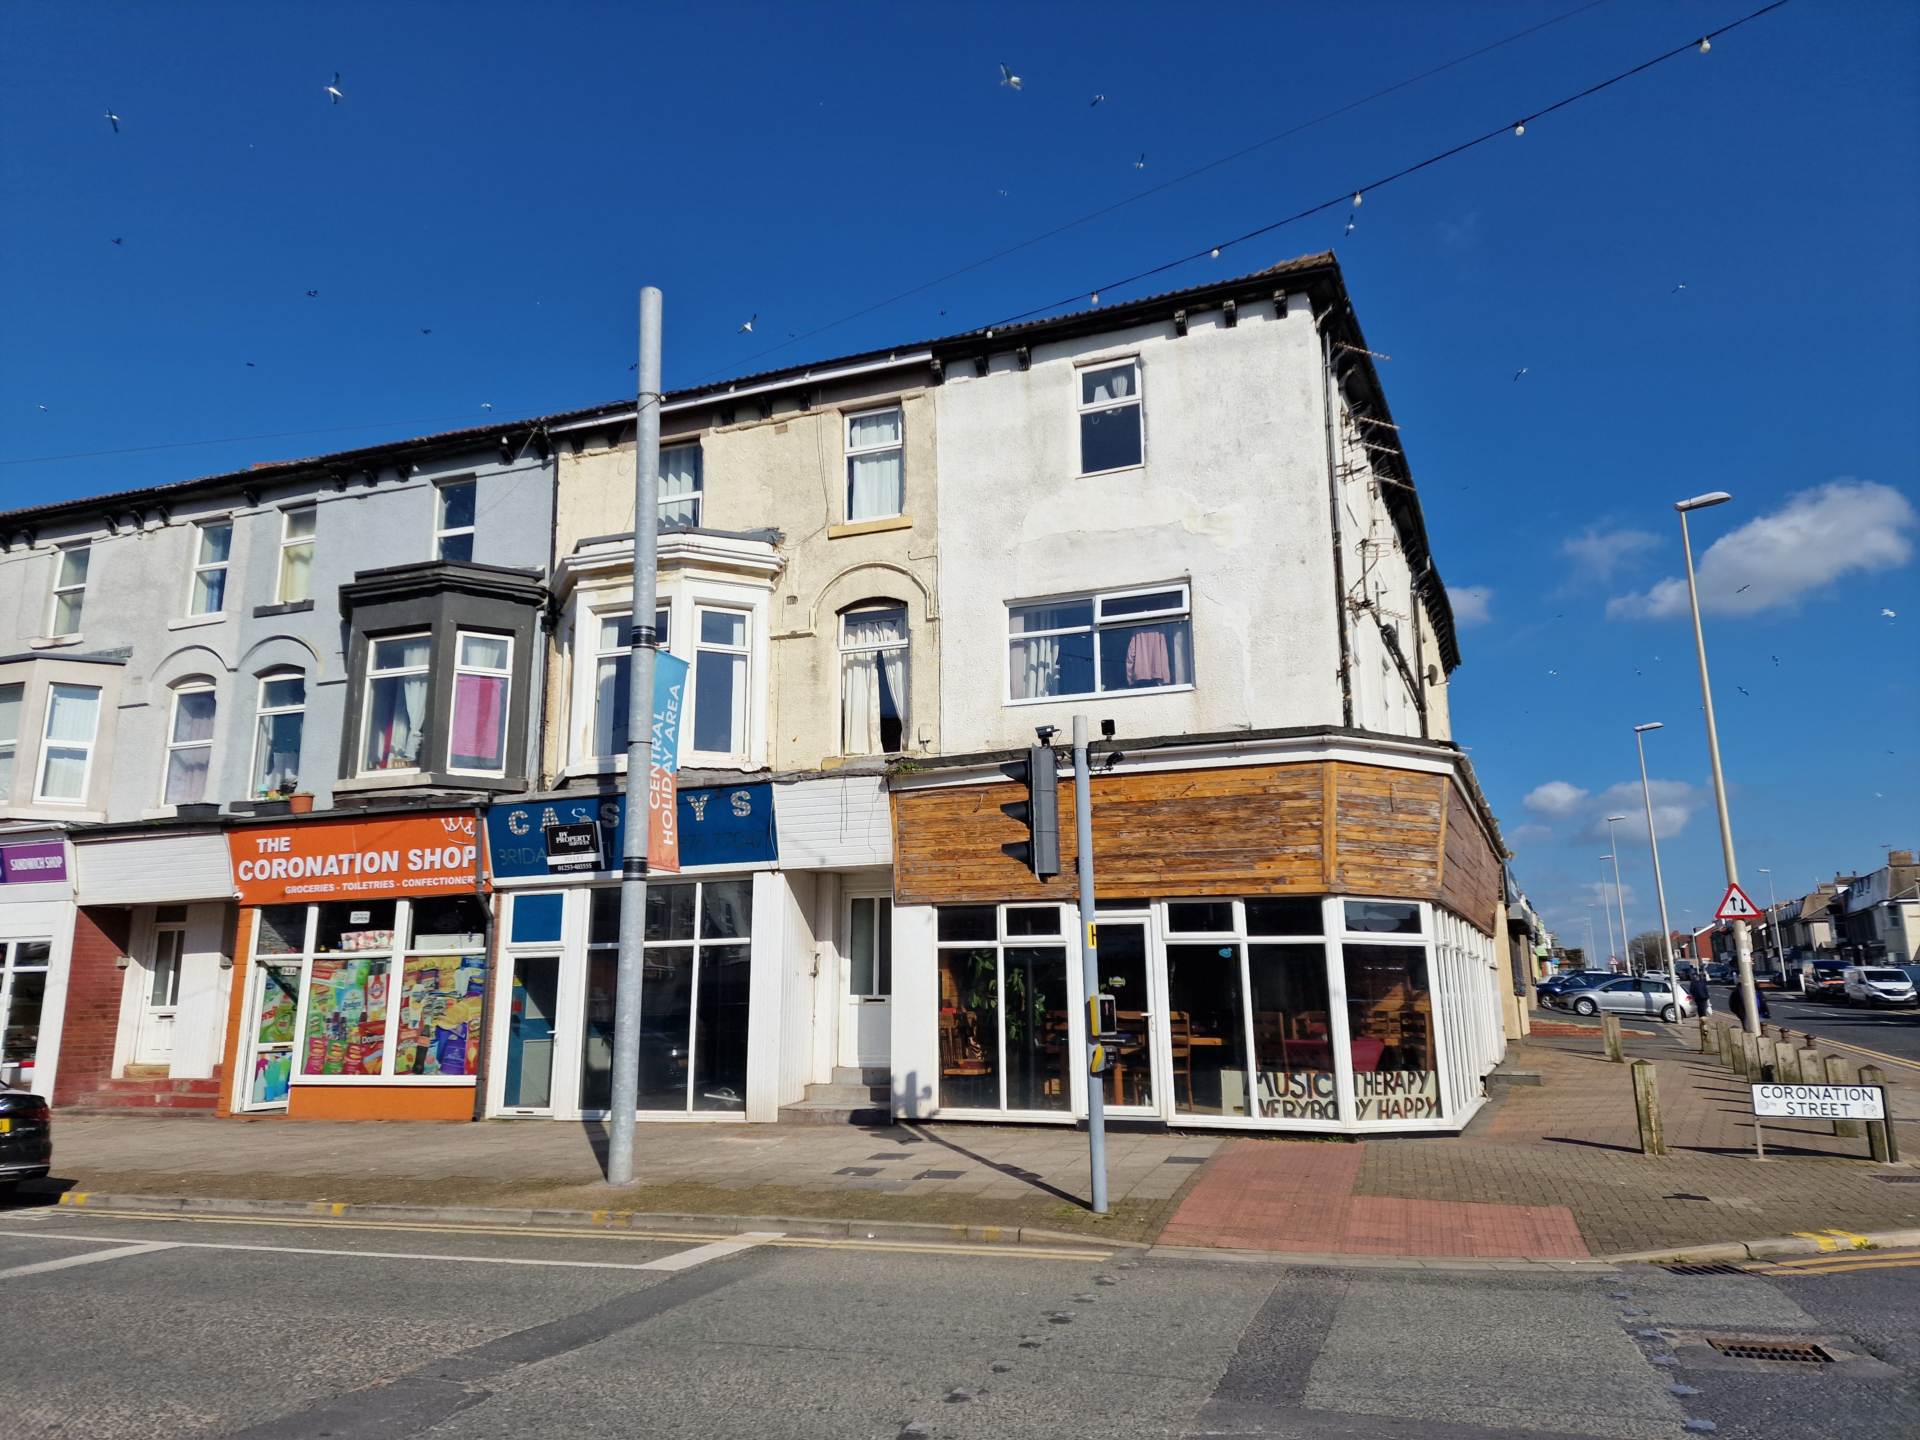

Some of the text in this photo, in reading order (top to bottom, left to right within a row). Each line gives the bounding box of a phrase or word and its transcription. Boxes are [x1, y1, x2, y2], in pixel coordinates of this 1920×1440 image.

[650, 711, 665, 809] CENTRAL
[661, 684, 681, 845] HOLIDAY AREA
[256, 836, 292, 853] THE
[556, 834, 591, 844] PROPERTY
[45, 856, 63, 869] SHOP
[238, 846, 476, 881] CORONATION SHOP
[285, 883, 335, 894] GROCERIES
[342, 880, 395, 891] TOILETRIES
[402, 875, 477, 887] CONFECTIONER
[1354, 1071, 1431, 1097] THERAPY
[1760, 1086, 1875, 1102] CORONATION
[1377, 1097, 1439, 1119] HAPPY
[1786, 1102, 1850, 1117] STREET
